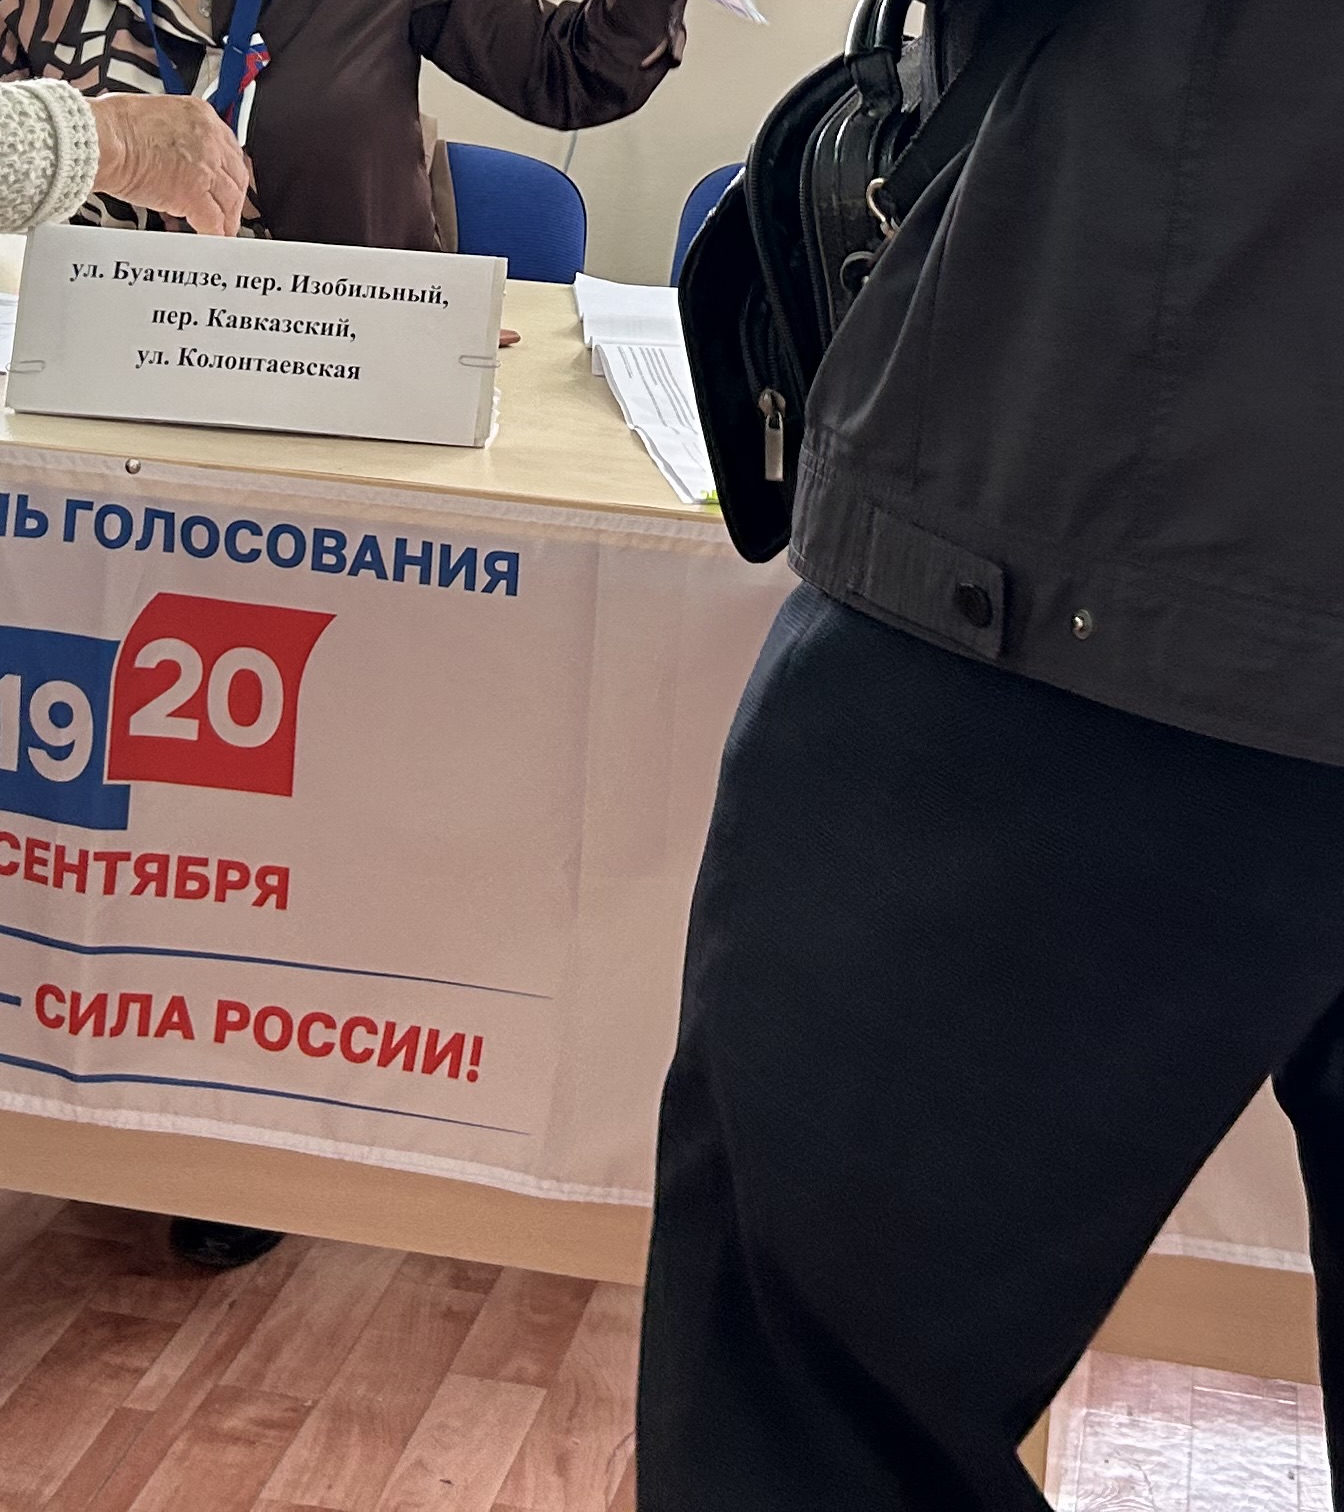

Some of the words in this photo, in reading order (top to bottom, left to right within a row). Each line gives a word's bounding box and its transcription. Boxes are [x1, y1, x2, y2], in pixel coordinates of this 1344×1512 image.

[70, 260, 104, 283] ул.
[113, 260, 228, 291] Буачидзе,
[235, 275, 282, 296] пер.
[290, 273, 449, 308] Изобильный,
[152, 310, 198, 331] пер.
[206, 308, 357, 342] Кавказский,
[135, 347, 170, 370] ул.
[177, 347, 361, 380] Колонтаевская
[62, 499, 522, 597] ГОЛОСОВАНИЯ
[129, 638, 284, 748] 20
[33, 984, 195, 1041] СИЛА
[215, 1009, 483, 1084] РОССИИ!
